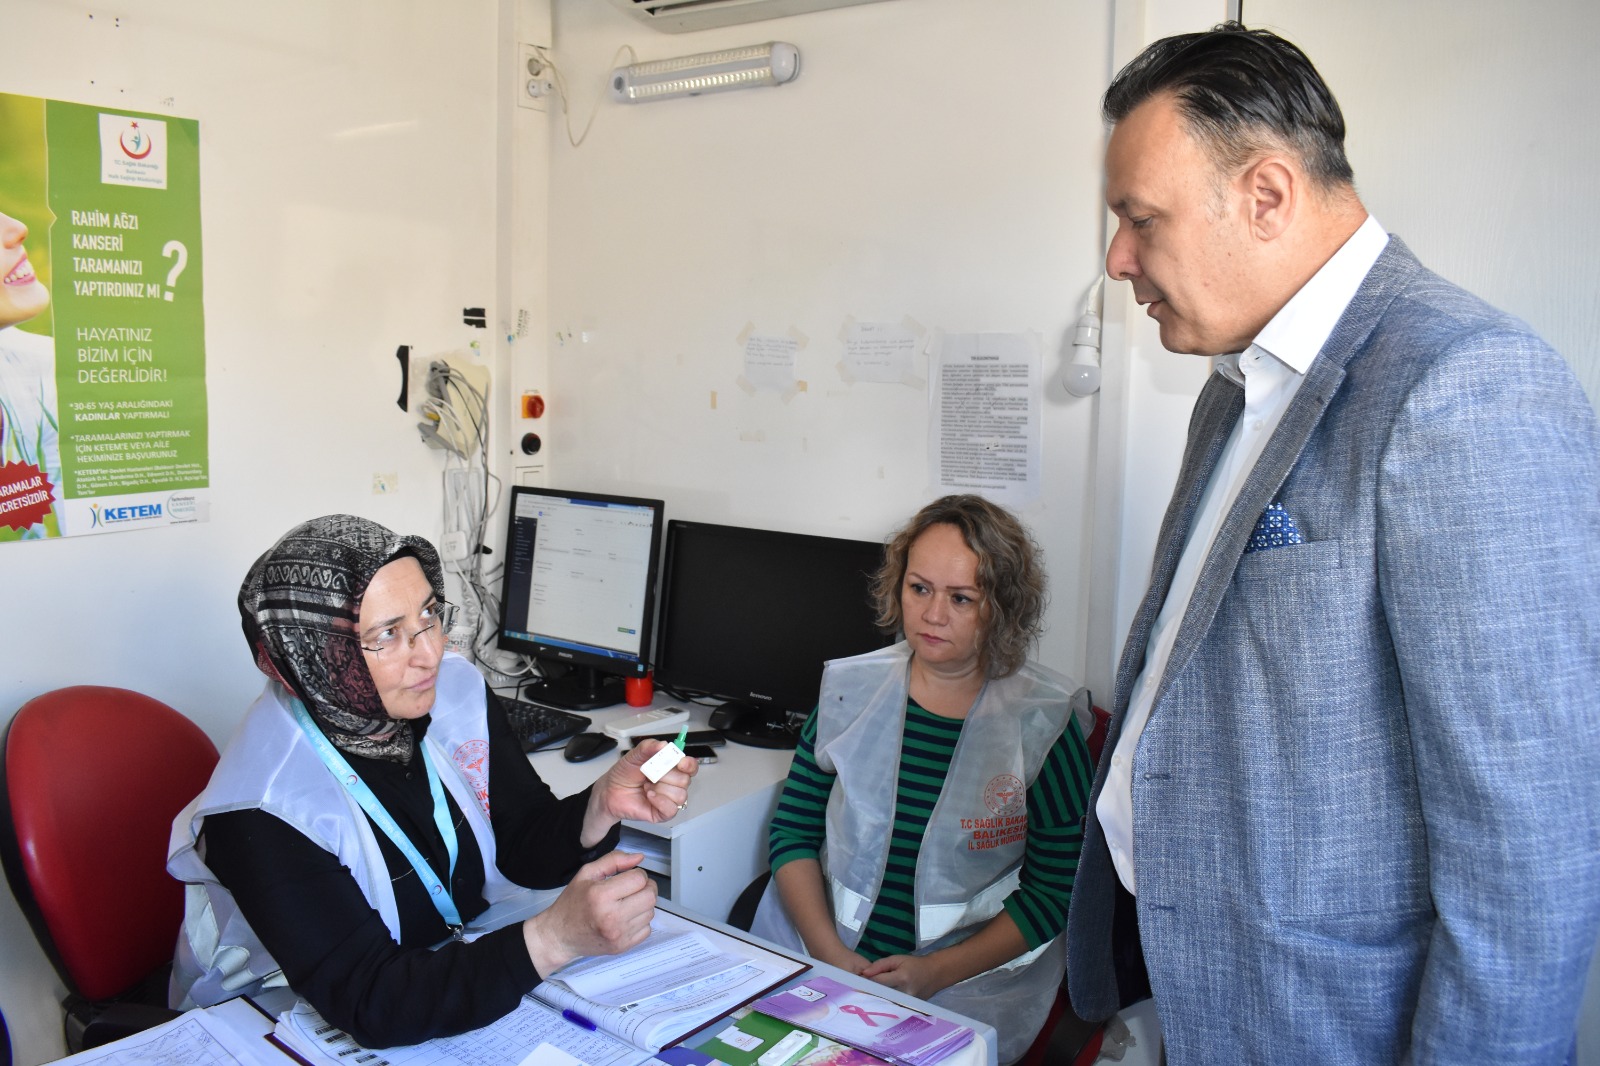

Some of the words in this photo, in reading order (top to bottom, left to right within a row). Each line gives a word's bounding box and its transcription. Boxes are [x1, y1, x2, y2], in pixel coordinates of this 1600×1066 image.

[71, 209, 110, 228] RAHİM
[113, 212, 139, 231] AĞZI
[72, 234, 124, 252] KANSERİ
[73, 257, 143, 276] TARAMANIZI
[73, 280, 144, 298] YAPTIRDINIZ
[147, 284, 161, 299] MI
[77, 327, 153, 343] HAYATINIZ
[78, 347, 119, 363] BİZİM
[123, 347, 153, 366] İÇİN
[78, 368, 168, 384] DEĞERLİDİR!
[98, 402, 115, 411] YAŞ
[116, 399, 174, 409] ARALIĞINDAKİ
[75, 412, 120, 421] KADINLAR
[122, 411, 170, 420] YAPTIRMALI
[145, 430, 191, 440] YAPTIRMAK
[75, 444, 93, 454] İÇİN
[94, 443, 129, 452] KETEM'E
[130, 442, 152, 450] VEYA
[153, 440, 170, 449] AİLE
[77, 453, 124, 463] HEKİMİNİZE
[125, 450, 178, 461] BAŞVURUNUZ
[0, 476, 43, 498] ARAMALAR
[105, 503, 162, 521] KETEM
[749, 692, 773, 701] lenovo
[960, 818, 973, 829] T.C
[974, 816, 1004, 829] SAĞLIK
[967, 840, 974, 850] İL
[976, 838, 998, 850] SAĞLIK
